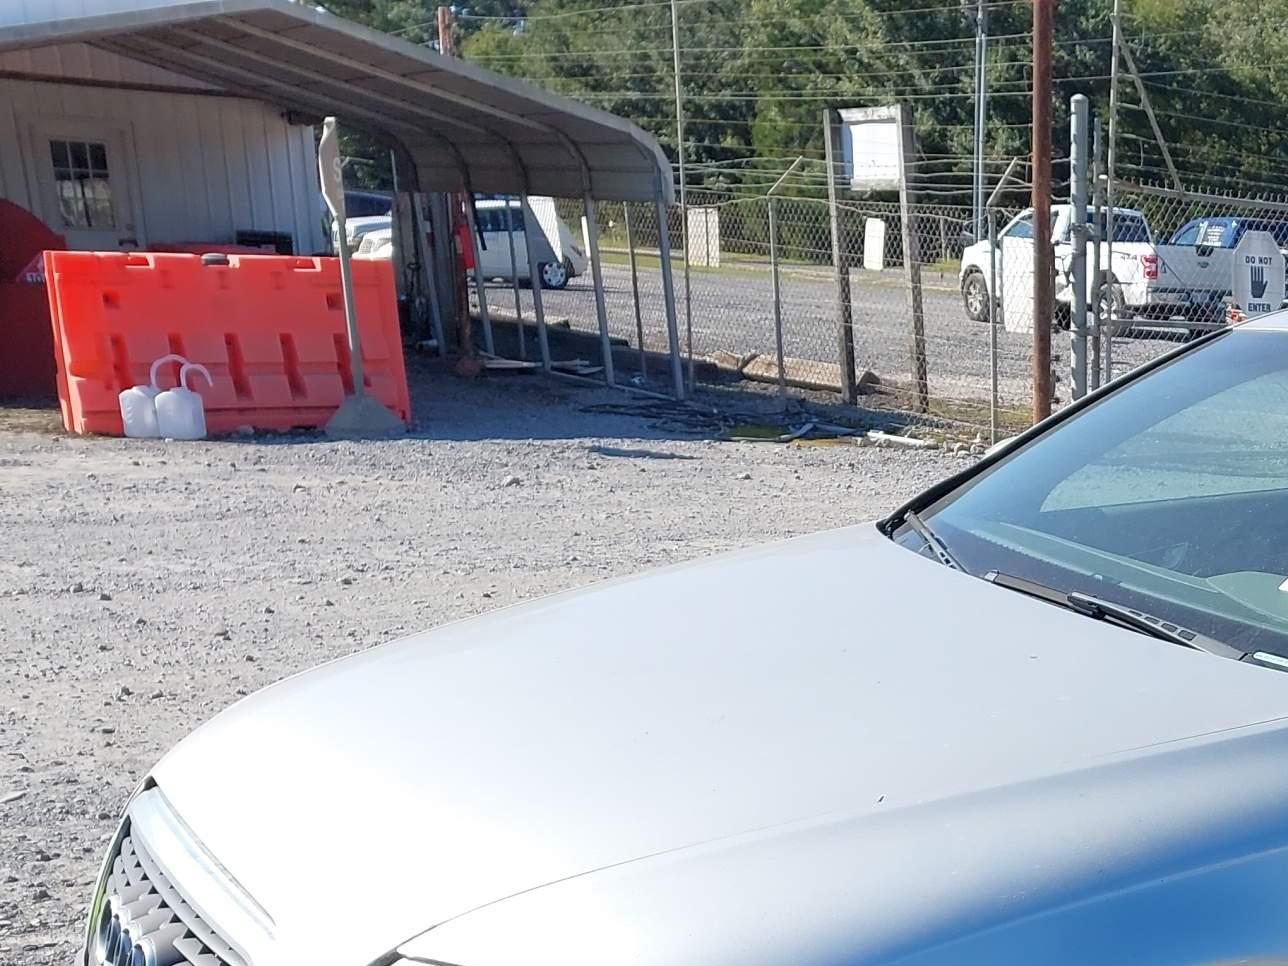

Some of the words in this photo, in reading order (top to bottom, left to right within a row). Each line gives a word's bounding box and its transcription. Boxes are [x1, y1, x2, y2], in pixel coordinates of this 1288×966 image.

[1245, 256, 1256, 264] DO
[1258, 256, 1272, 265] NOT
[1248, 303, 1271, 312] ENTER
